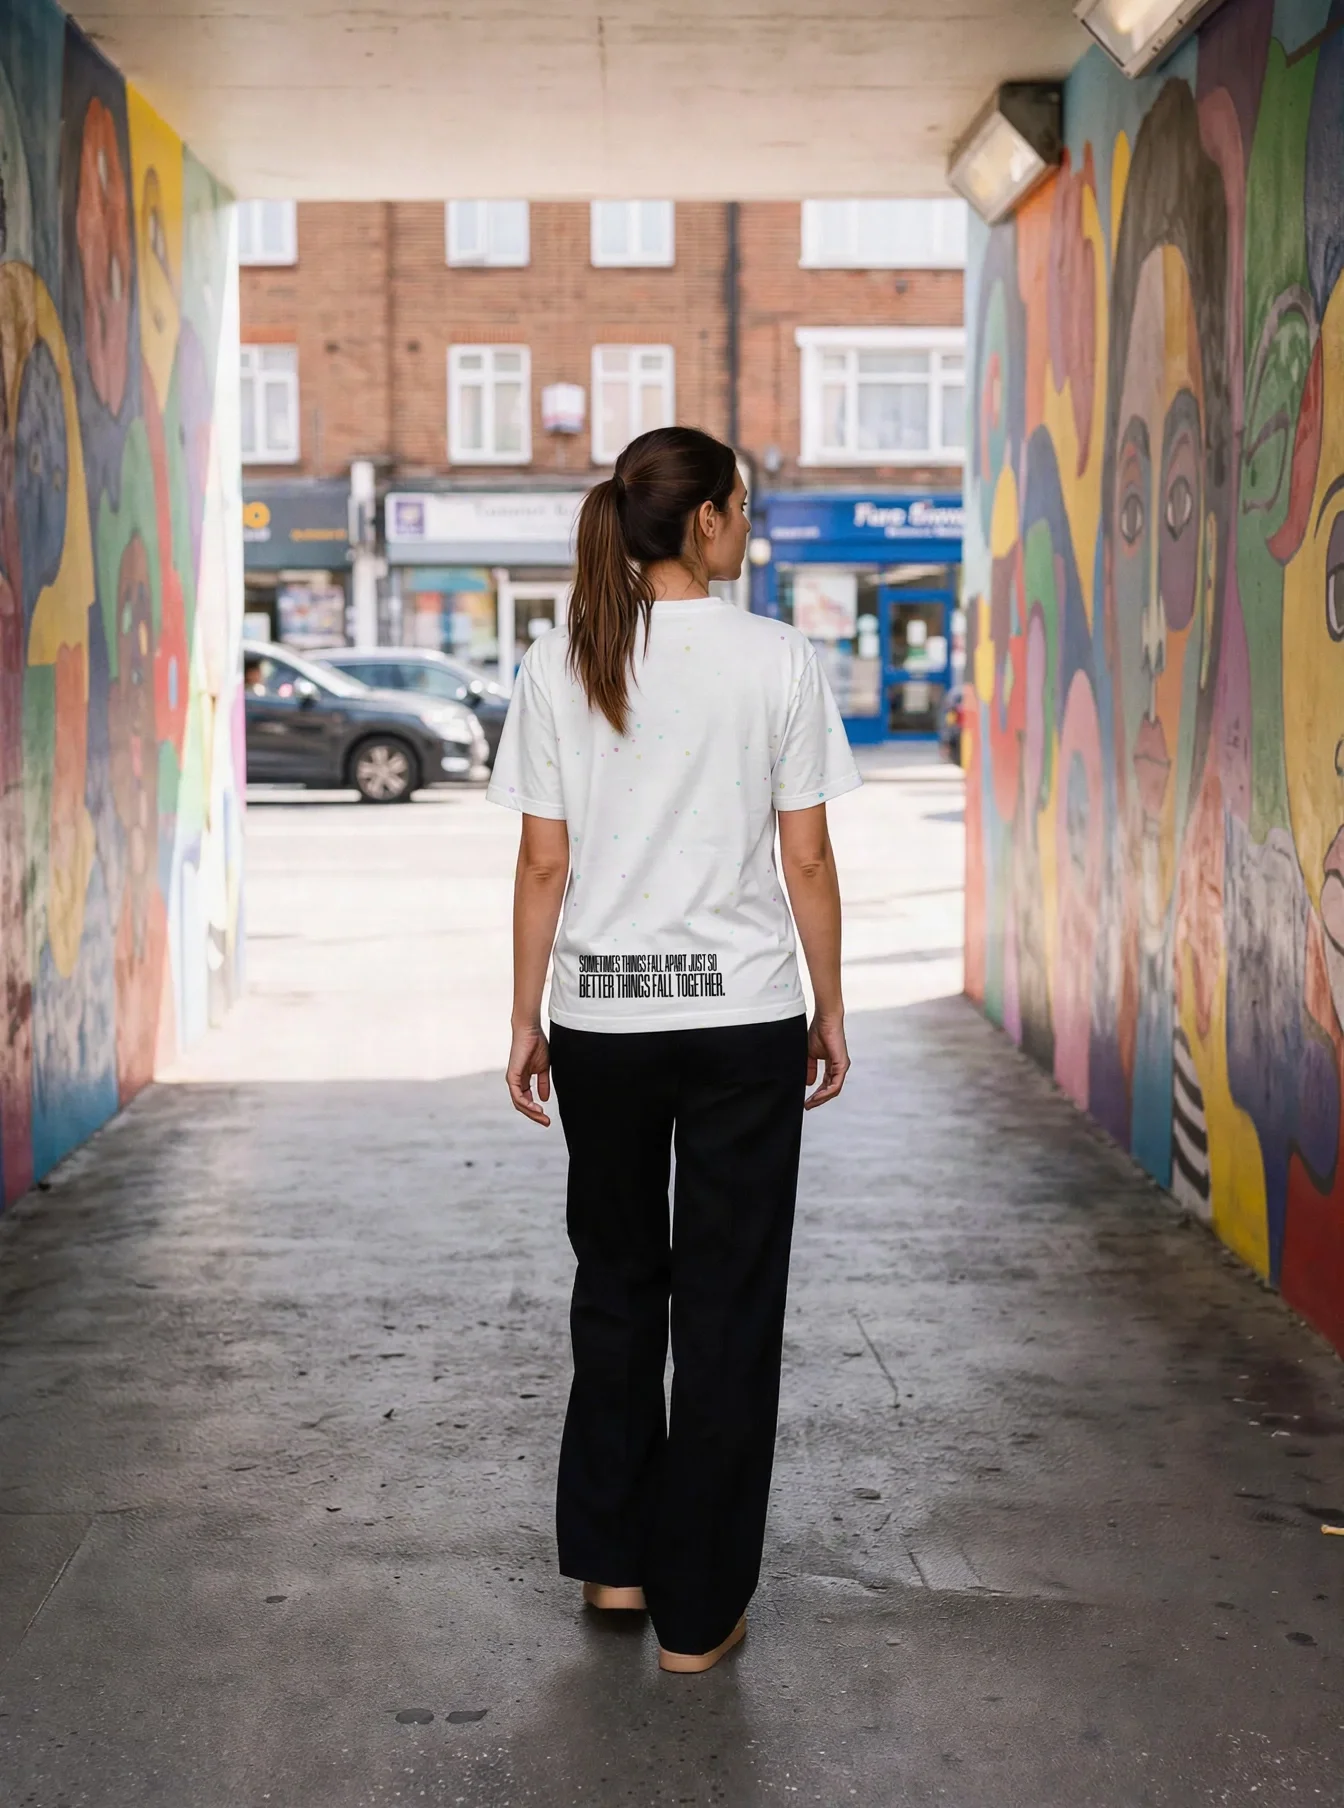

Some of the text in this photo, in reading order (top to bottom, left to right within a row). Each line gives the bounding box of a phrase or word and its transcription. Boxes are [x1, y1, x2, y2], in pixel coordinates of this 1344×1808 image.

[579, 953, 717, 973] SOMETIMES THINGS FALL APART JUST SO
[579, 973, 725, 998] BETTER THINGS FALL TOGETHER.
